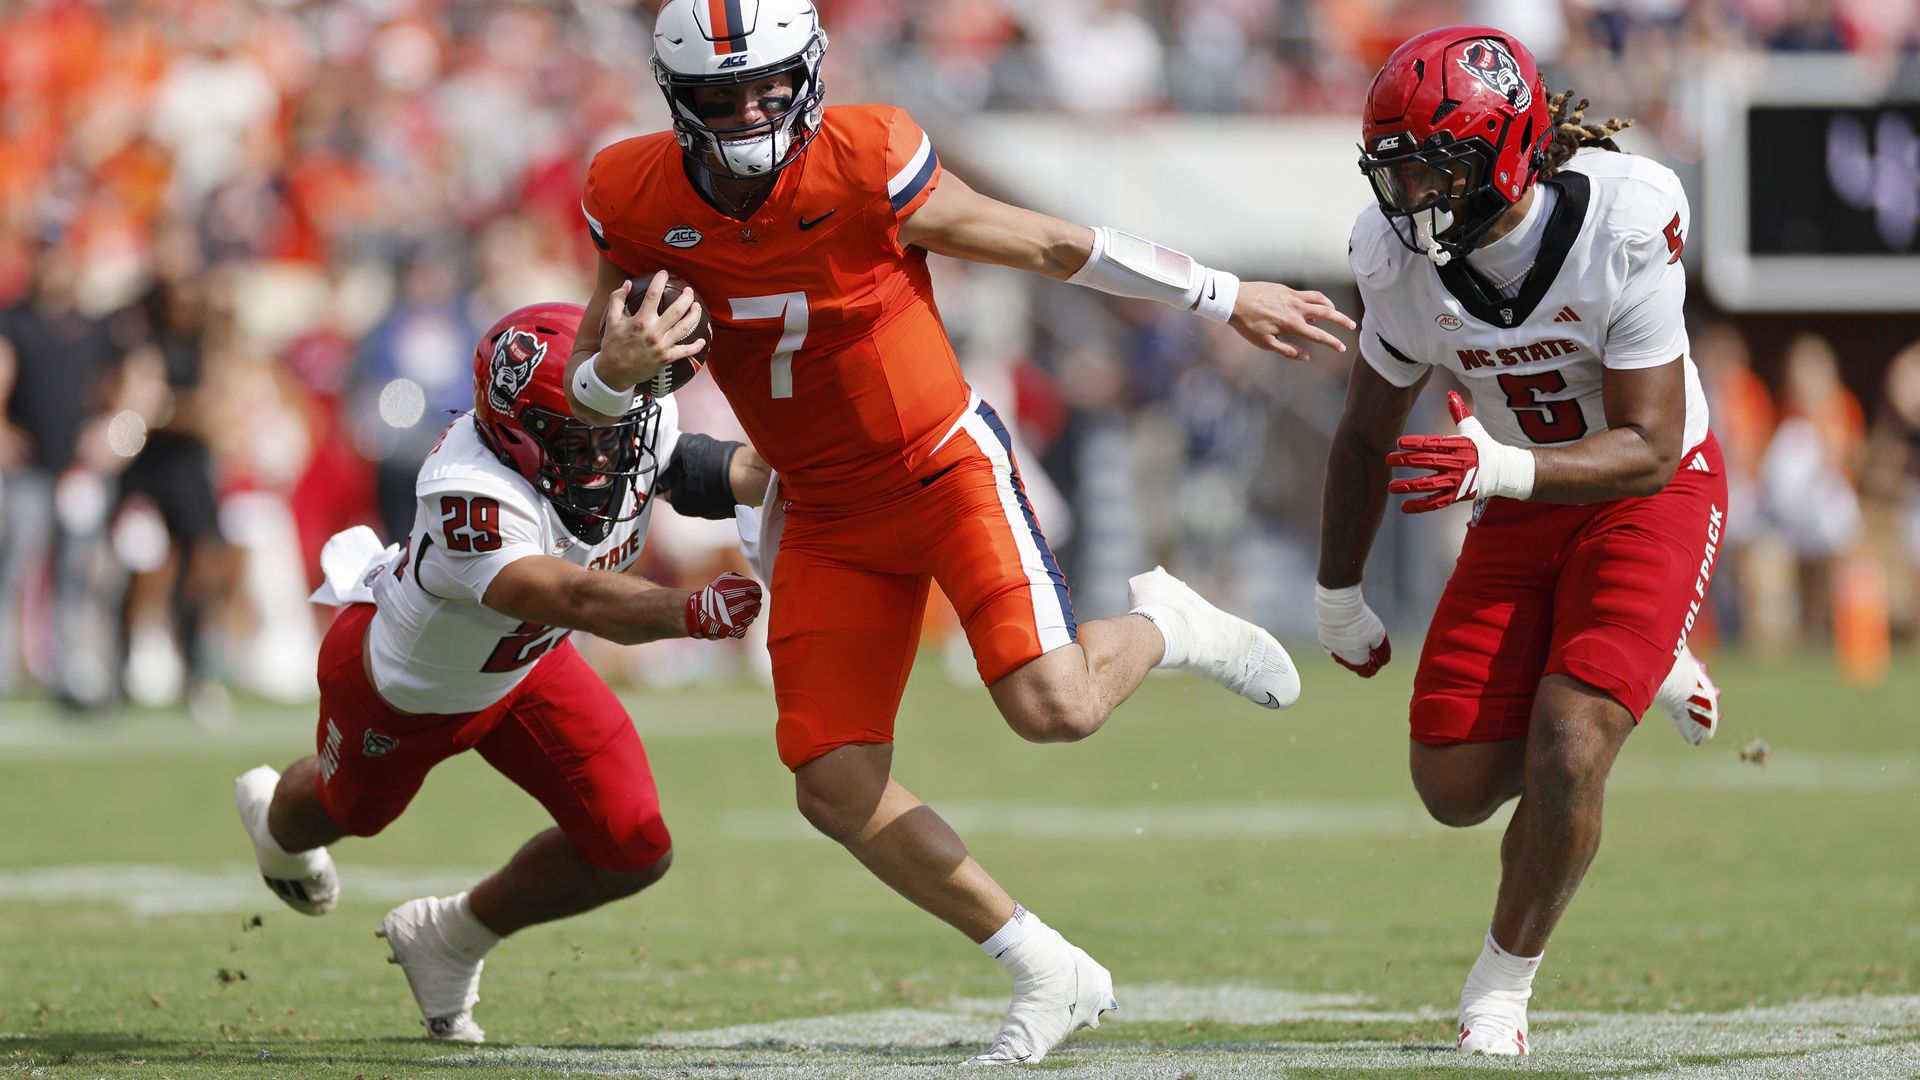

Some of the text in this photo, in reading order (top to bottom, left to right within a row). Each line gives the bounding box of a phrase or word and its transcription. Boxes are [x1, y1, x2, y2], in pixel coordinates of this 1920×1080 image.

[717, 54, 748, 69] ACC
[1376, 136, 1400, 152] ACC
[668, 231, 697, 244] ACC
[1662, 210, 1684, 266] 5
[1439, 314, 1459, 326] ACC
[727, 290, 810, 399] 7
[1456, 338, 1580, 371] NC STATE
[1496, 369, 1588, 444] 5
[440, 496, 502, 552] 29
[1673, 504, 1722, 659] WOLFPACK
